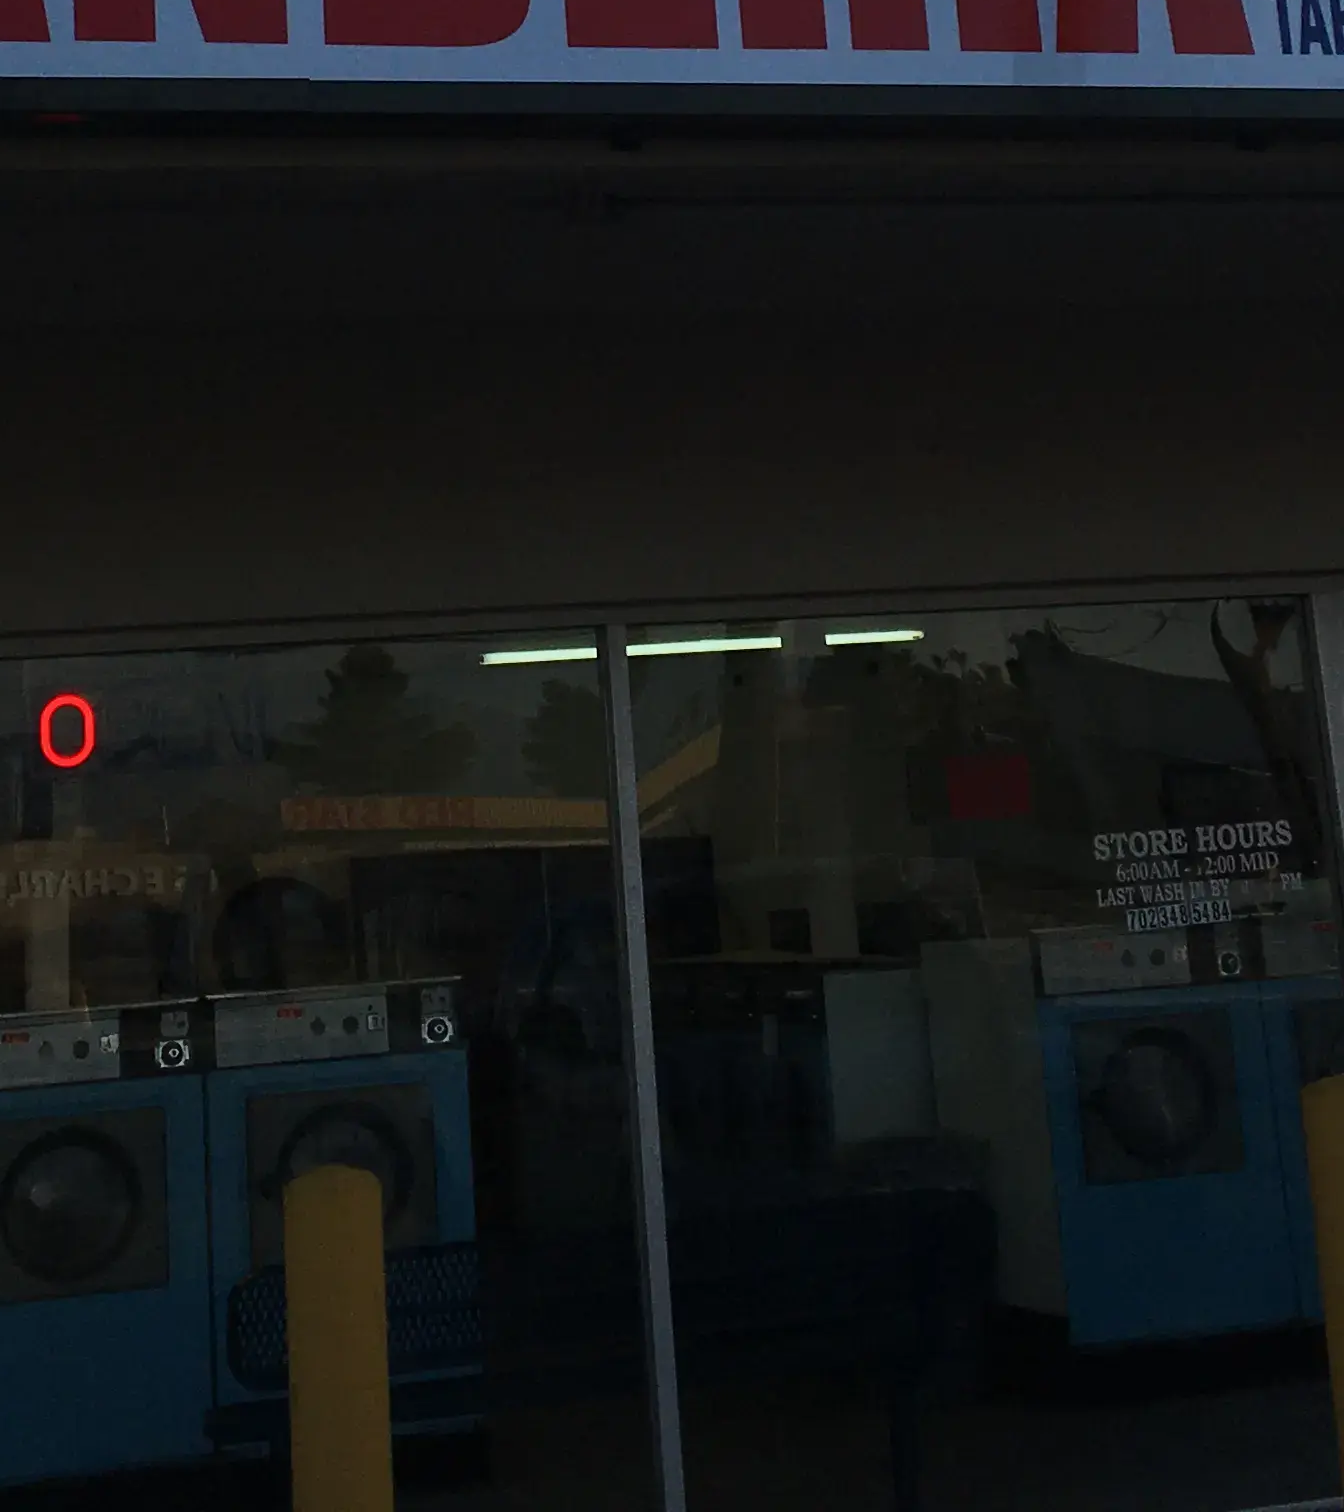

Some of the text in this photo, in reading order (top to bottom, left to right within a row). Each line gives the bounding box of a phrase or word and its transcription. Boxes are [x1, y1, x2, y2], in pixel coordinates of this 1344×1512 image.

[1093, 819, 1293, 862] STORE HOURS
[1239, 851, 1280, 873] MID
[1096, 888, 1136, 908] LAST
[1140, 880, 1185, 904] WASH
[1189, 881, 1206, 900] IN
[1211, 878, 1230, 898] BY
[1280, 872, 1304, 891] PM
